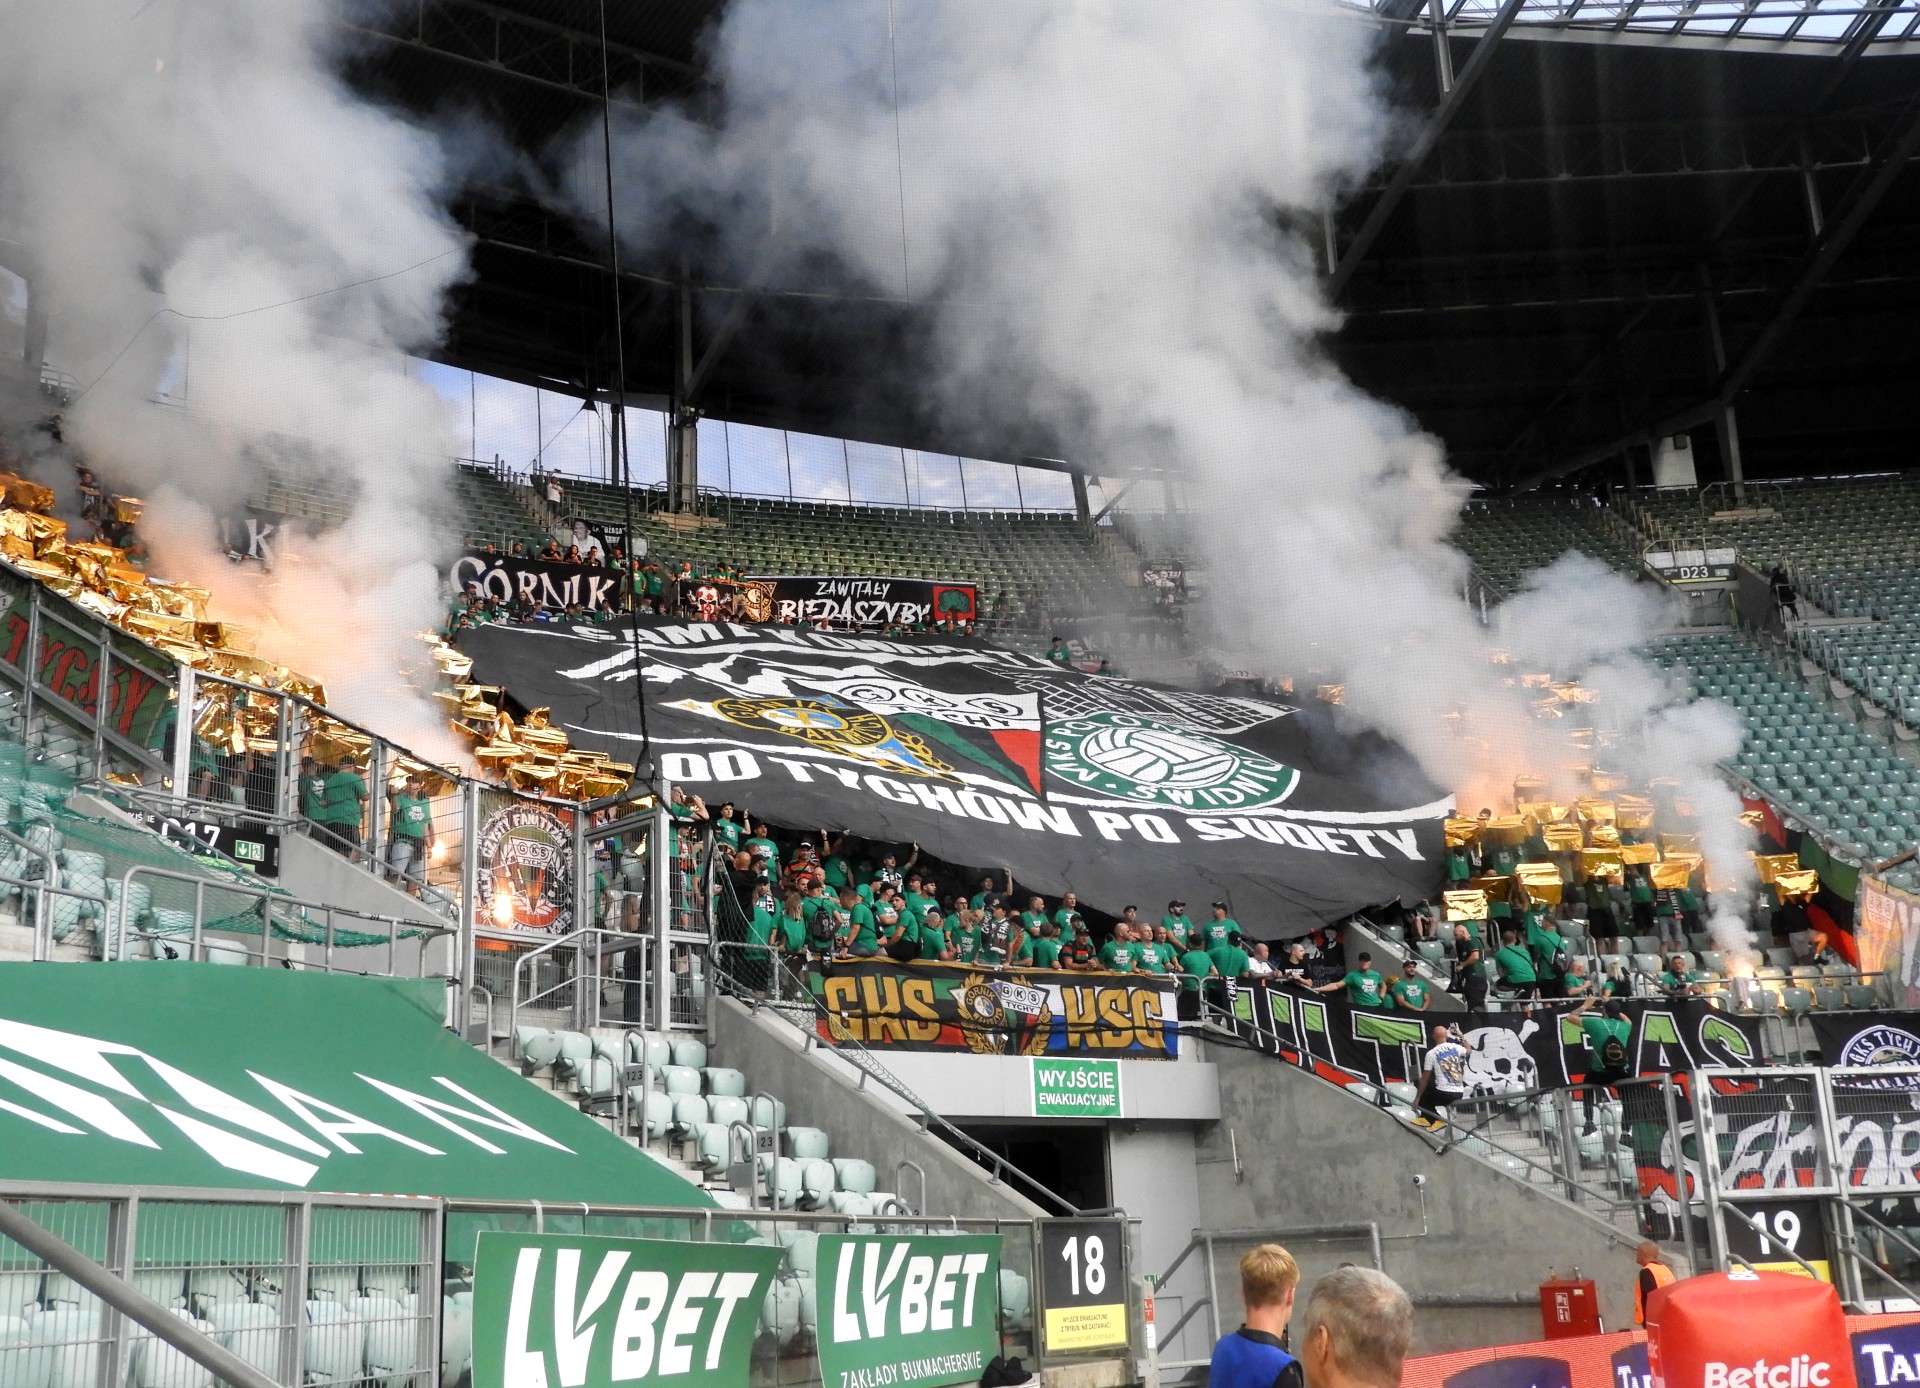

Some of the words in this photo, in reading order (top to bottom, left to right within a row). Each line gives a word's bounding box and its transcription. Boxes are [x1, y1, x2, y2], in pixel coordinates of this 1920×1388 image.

[451, 556, 615, 612] GÓRNIK
[1680, 566, 1709, 579] D23
[815, 580, 891, 599] ZAWITAŁY
[780, 597, 932, 625] BIEDASZYBY
[661, 749, 762, 782] OD
[768, 757, 1083, 838] TYCHÓW
[1088, 810, 1182, 844] PO
[1186, 817, 1426, 861] SUDETY
[517, 841, 549, 860] GKS
[1002, 984, 1040, 1005] GKS
[824, 976, 941, 1041] GKS
[1006, 1001, 1035, 1013] TYCHY
[1849, 1038, 1876, 1063] GKS
[626, 1071, 643, 1081] 123
[1039, 1067, 1115, 1090] WYJŚCIE
[1039, 1092, 1116, 1107] EWAKUACYJNE
[1750, 1209, 1801, 1255] 19
[1061, 1235, 1106, 1296] 18
[840, 1363, 898, 1388] ZAKŁADY
[901, 1350, 982, 1381] BUKMACHERSKIE
[1617, 1365, 1651, 1388] TA
[1704, 1353, 1831, 1388] Betclic
